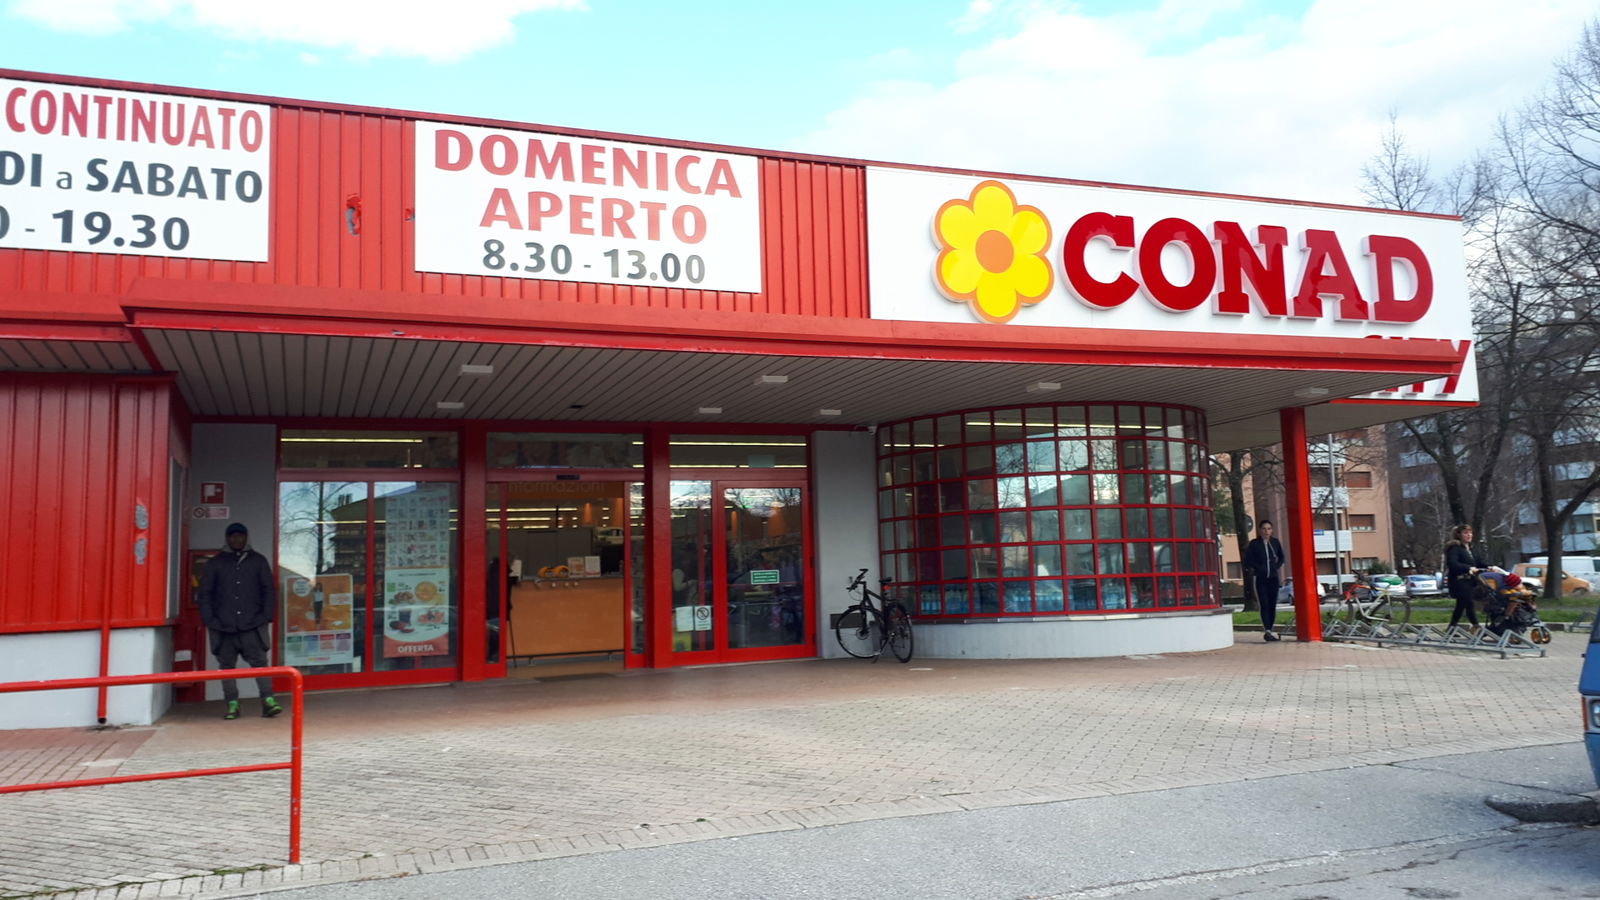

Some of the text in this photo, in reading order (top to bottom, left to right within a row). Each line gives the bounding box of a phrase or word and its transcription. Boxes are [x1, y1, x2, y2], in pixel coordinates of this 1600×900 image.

[5, 87, 263, 153] CONTINUATO
[56, 171, 73, 190] a
[86, 158, 263, 203] SABATO
[435, 129, 743, 198] DOMENICA
[52, 209, 190, 251] 19.30
[479, 187, 707, 244] APERTO
[482, 239, 573, 275] 8.30
[603, 249, 706, 284] 13.00
[1061, 211, 1434, 324] CONAD
[506, 481, 606, 494] nformazioni
[397, 644, 434, 654] OFFERTA
